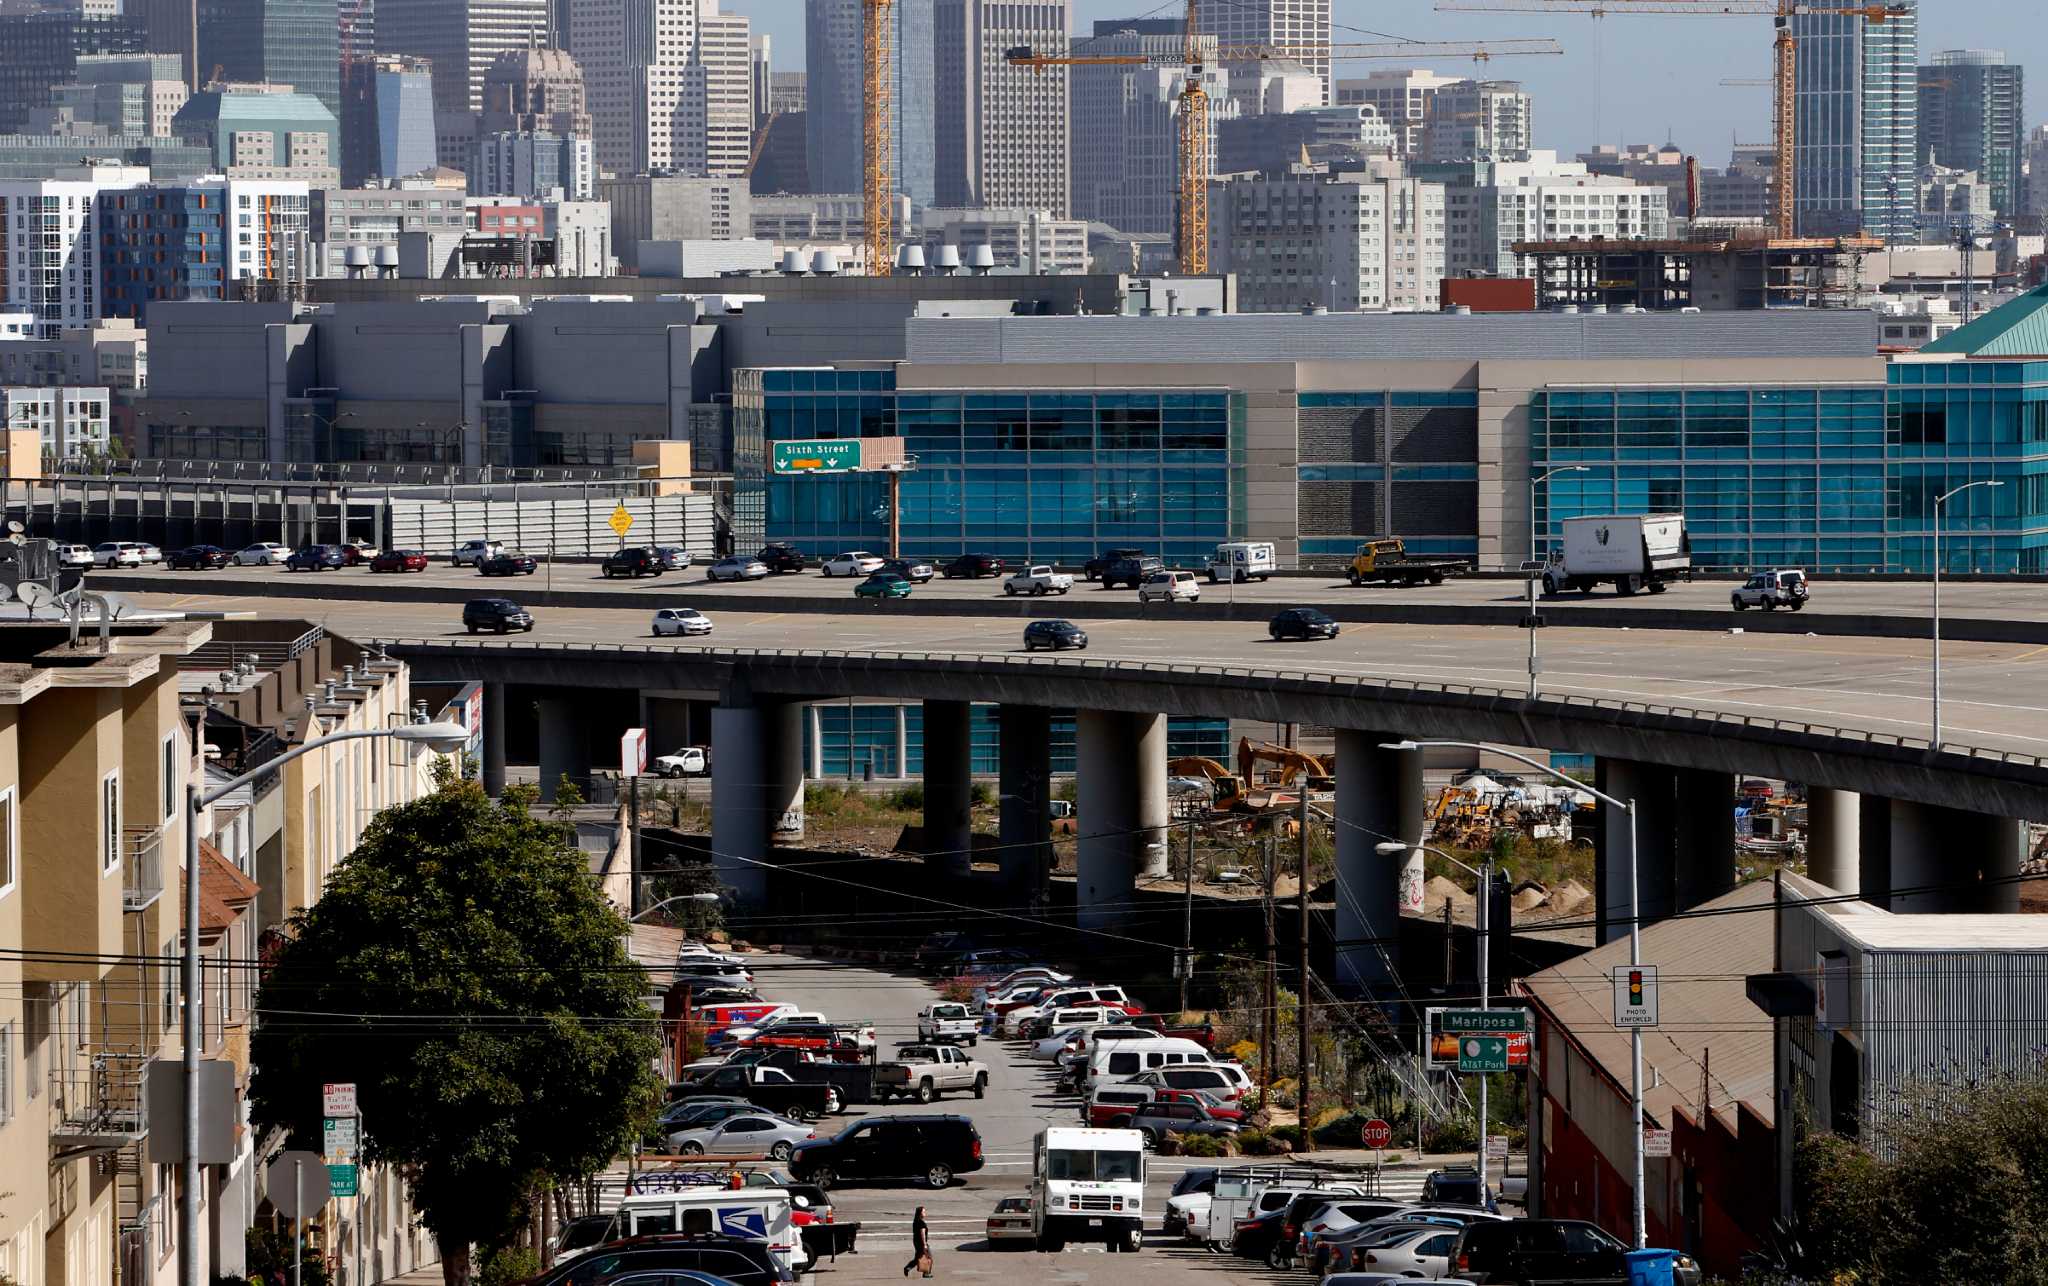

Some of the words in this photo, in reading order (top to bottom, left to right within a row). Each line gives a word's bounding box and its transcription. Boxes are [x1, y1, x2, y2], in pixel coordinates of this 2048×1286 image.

[786, 446, 812, 454] Sixth
[817, 445, 849, 453] Street
[1452, 1016, 1516, 1029] Mariposa
[1461, 1060, 1482, 1069] AT&T
[1485, 1060, 1505, 1069] Park
[324, 1085, 333, 1094] NO
[326, 1120, 334, 1129] 2
[1364, 1128, 1389, 1140] STOP
